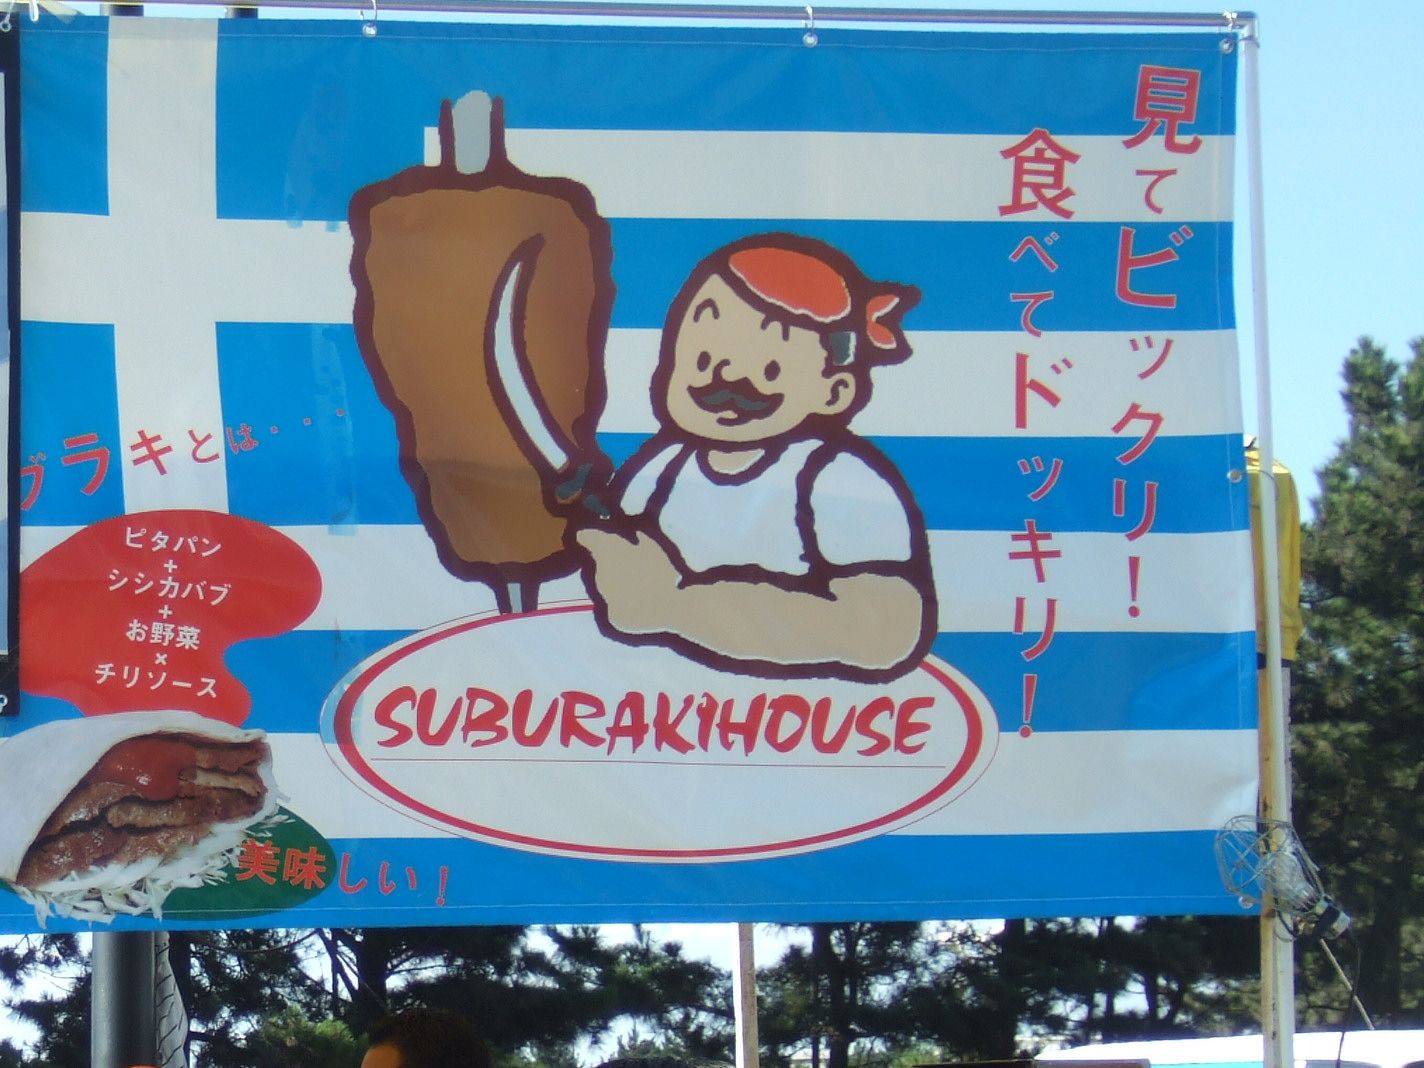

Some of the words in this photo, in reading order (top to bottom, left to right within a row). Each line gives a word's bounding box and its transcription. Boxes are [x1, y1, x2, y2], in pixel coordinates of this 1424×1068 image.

[126, 527, 222, 558] ピタパン
[108, 569, 231, 606] シシカバブ
[126, 619, 201, 650] お野菜
[94, 662, 218, 698] チリソース
